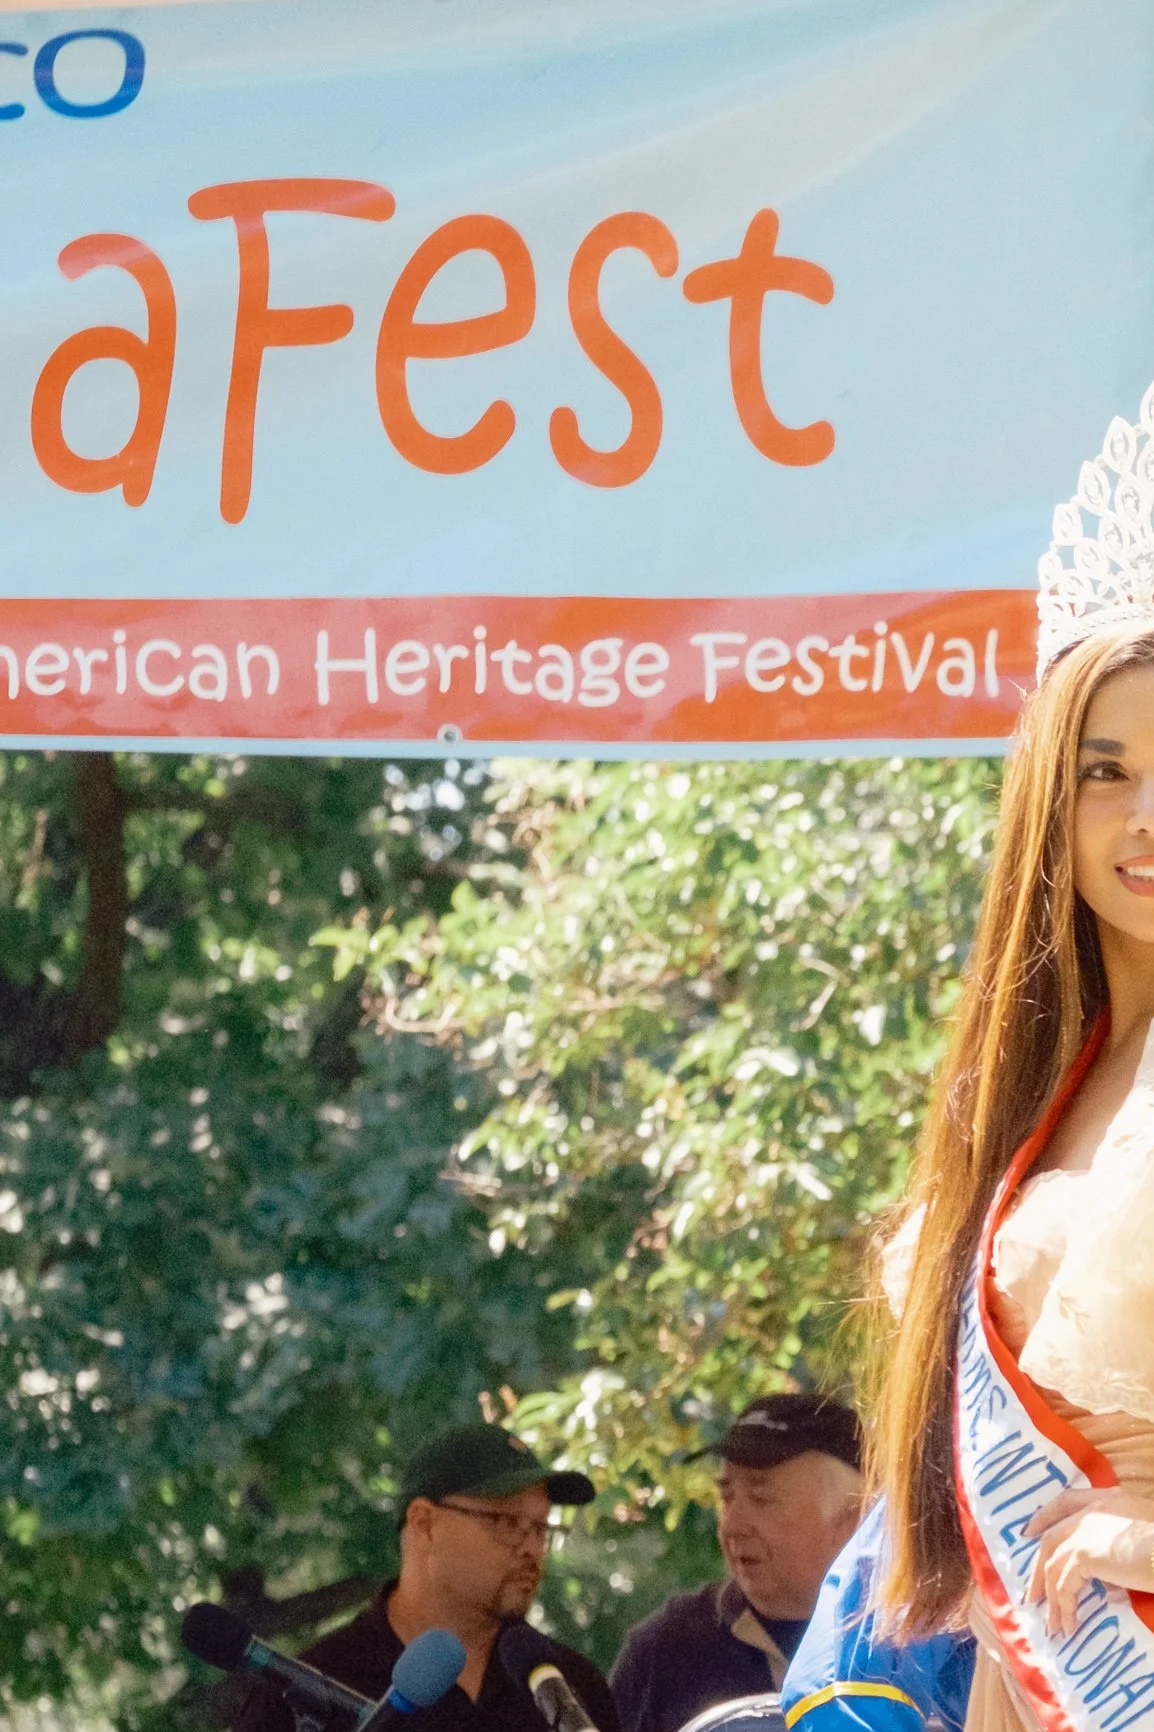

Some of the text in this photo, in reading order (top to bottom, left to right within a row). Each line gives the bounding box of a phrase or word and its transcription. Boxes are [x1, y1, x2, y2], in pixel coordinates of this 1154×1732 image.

[30, 176, 835, 525] aFest
[313, 625, 671, 708] Heritage
[690, 621, 1001, 704] Festival
